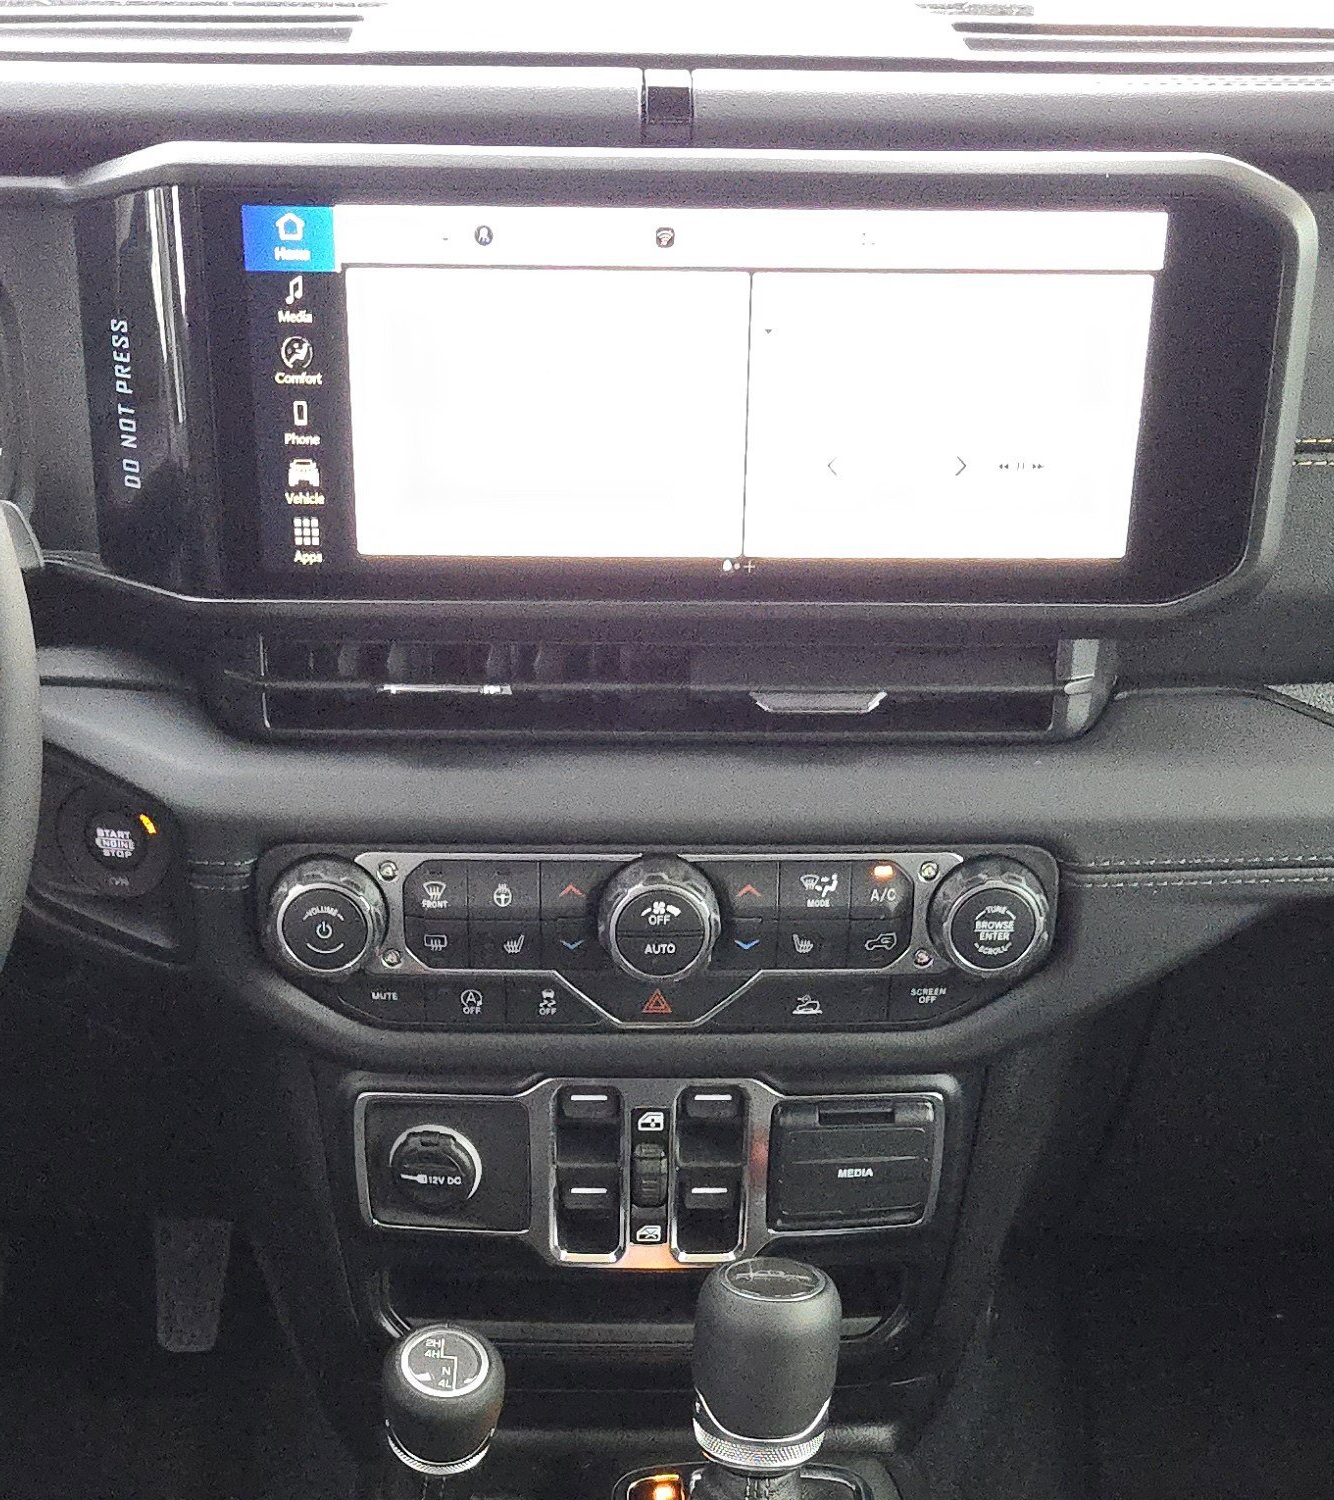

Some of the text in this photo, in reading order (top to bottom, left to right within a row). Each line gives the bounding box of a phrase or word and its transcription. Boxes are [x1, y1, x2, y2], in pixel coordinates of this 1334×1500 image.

[277, 310, 312, 323] Media
[274, 372, 322, 385] Comfort
[110, 318, 141, 489] DO NOT PRESS
[284, 433, 320, 446] Phone
[285, 492, 324, 505] Vehicle
[294, 551, 323, 564] Apps
[96, 827, 131, 839] START
[102, 849, 132, 858] STOP
[870, 887, 896, 902] A/C
[422, 899, 448, 909] FRONT
[807, 899, 830, 908] MODE
[648, 915, 670, 926] OFF
[975, 920, 1014, 930] BROWSE
[979, 931, 1010, 941] ENTER
[644, 943, 676, 954] AUTO
[371, 992, 398, 1001] MUTE
[910, 988, 947, 996] SCREEN
[919, 996, 937, 1004] OFF
[463, 1006, 481, 1015] OFF
[539, 1007, 556, 1015] OFF
[838, 1167, 874, 1178] MEDIA
[429, 1176, 445, 1185] 12V
[426, 1339, 441, 1348] 2H
[424, 1350, 440, 1359] 4H
[442, 1367, 451, 1375] N
[438, 1379, 451, 1387] 4L
